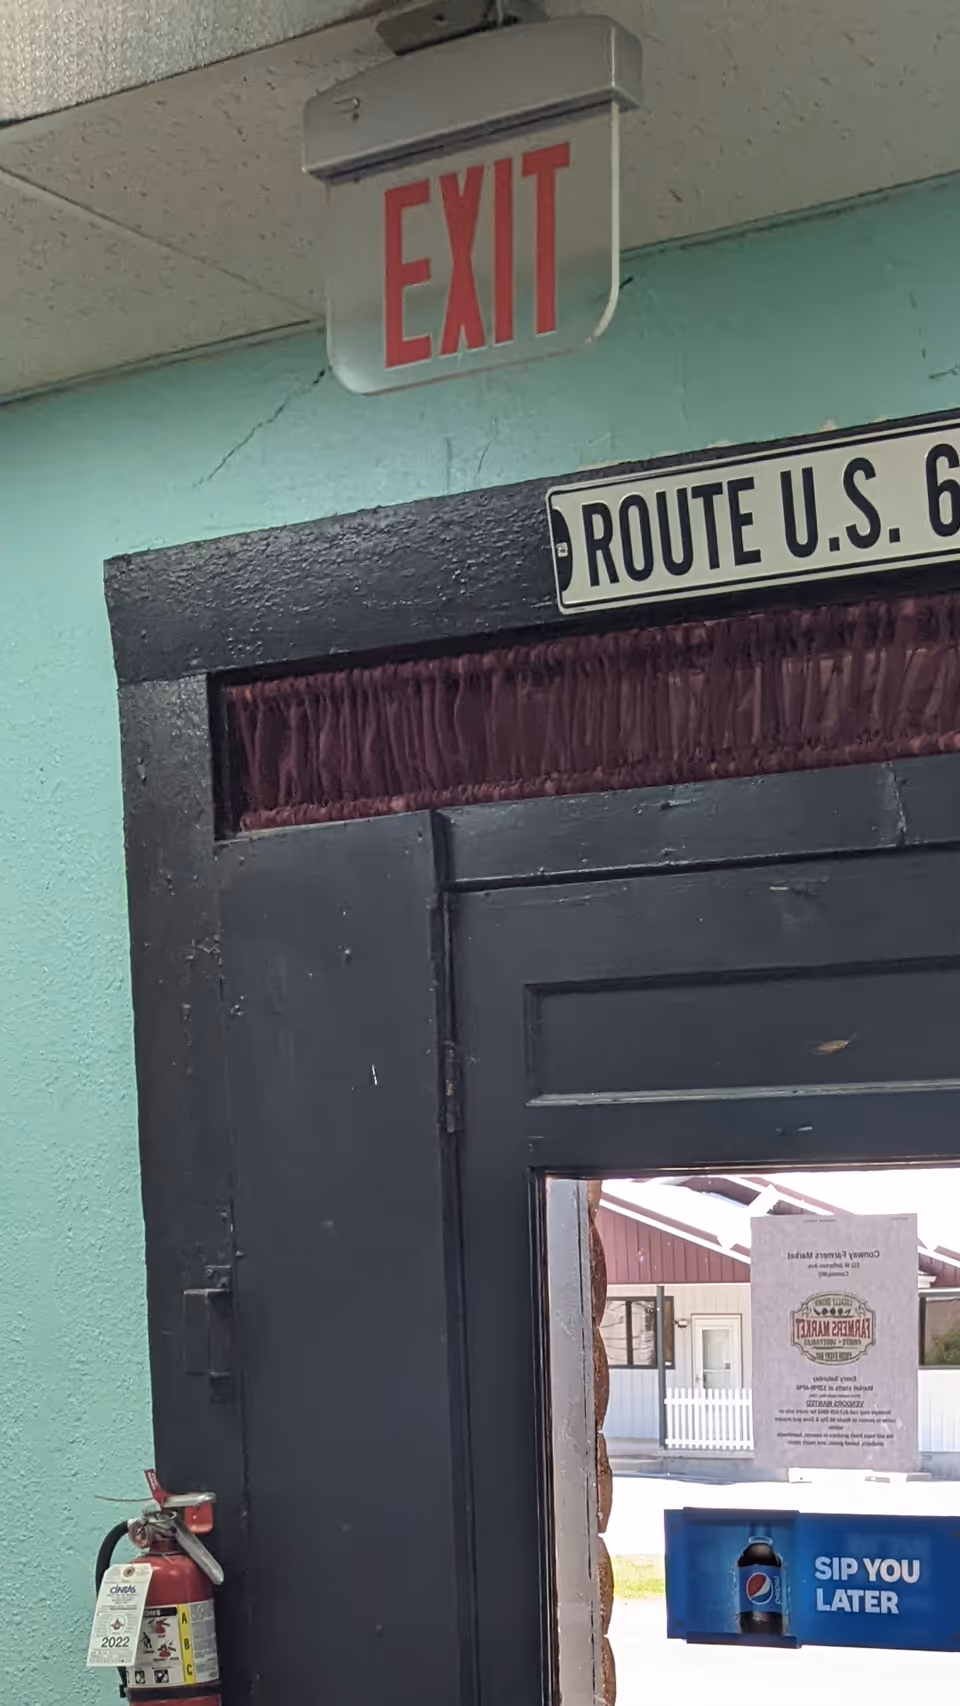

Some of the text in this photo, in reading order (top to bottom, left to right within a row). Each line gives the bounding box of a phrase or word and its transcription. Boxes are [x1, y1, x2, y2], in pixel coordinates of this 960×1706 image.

[384, 142, 571, 370] EXIT
[581, 476, 762, 587] ROUTE
[780, 457, 901, 558] U.S.
[815, 1556, 921, 1584] SIP YOU
[816, 1588, 899, 1614] LATER
[181, 1612, 188, 1624] A
[101, 1636, 130, 1648] 2022
[184, 1638, 190, 1650] B
[186, 1664, 193, 1675] C
